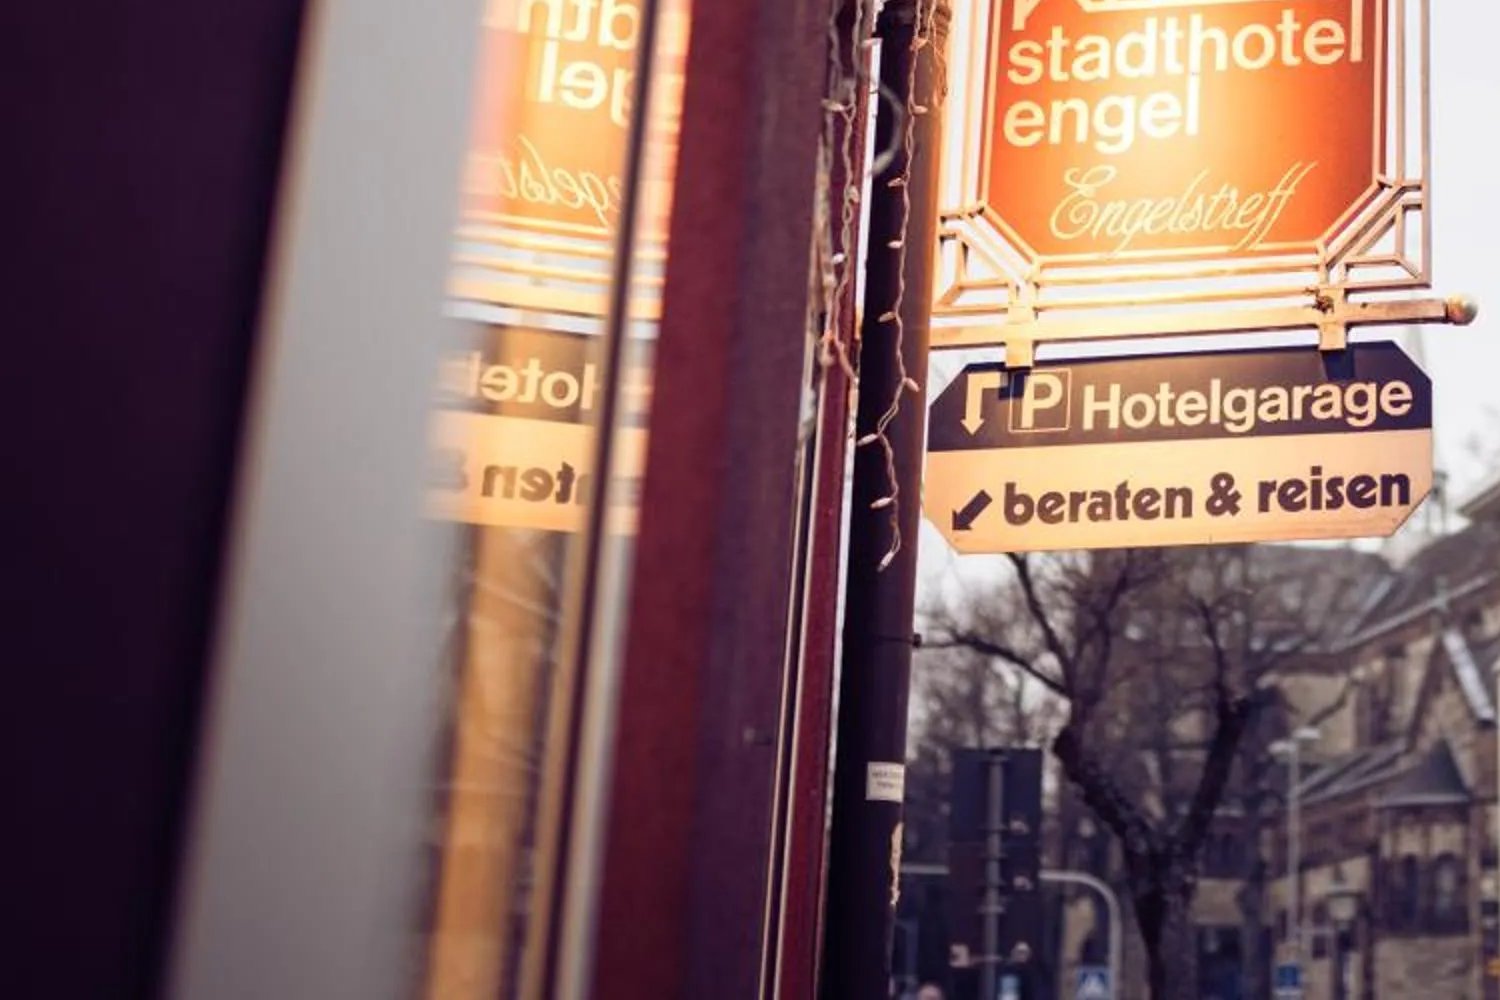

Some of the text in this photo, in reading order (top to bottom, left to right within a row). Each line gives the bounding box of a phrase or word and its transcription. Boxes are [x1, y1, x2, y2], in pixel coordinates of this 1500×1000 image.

[1007, 4, 1364, 86] stadthotel
[1003, 74, 1200, 154] engel
[1049, 160, 1319, 258] Engelstreff
[1020, 373, 1413, 433] P Hotelgarage
[1003, 465, 1411, 527] beraten & reisen
